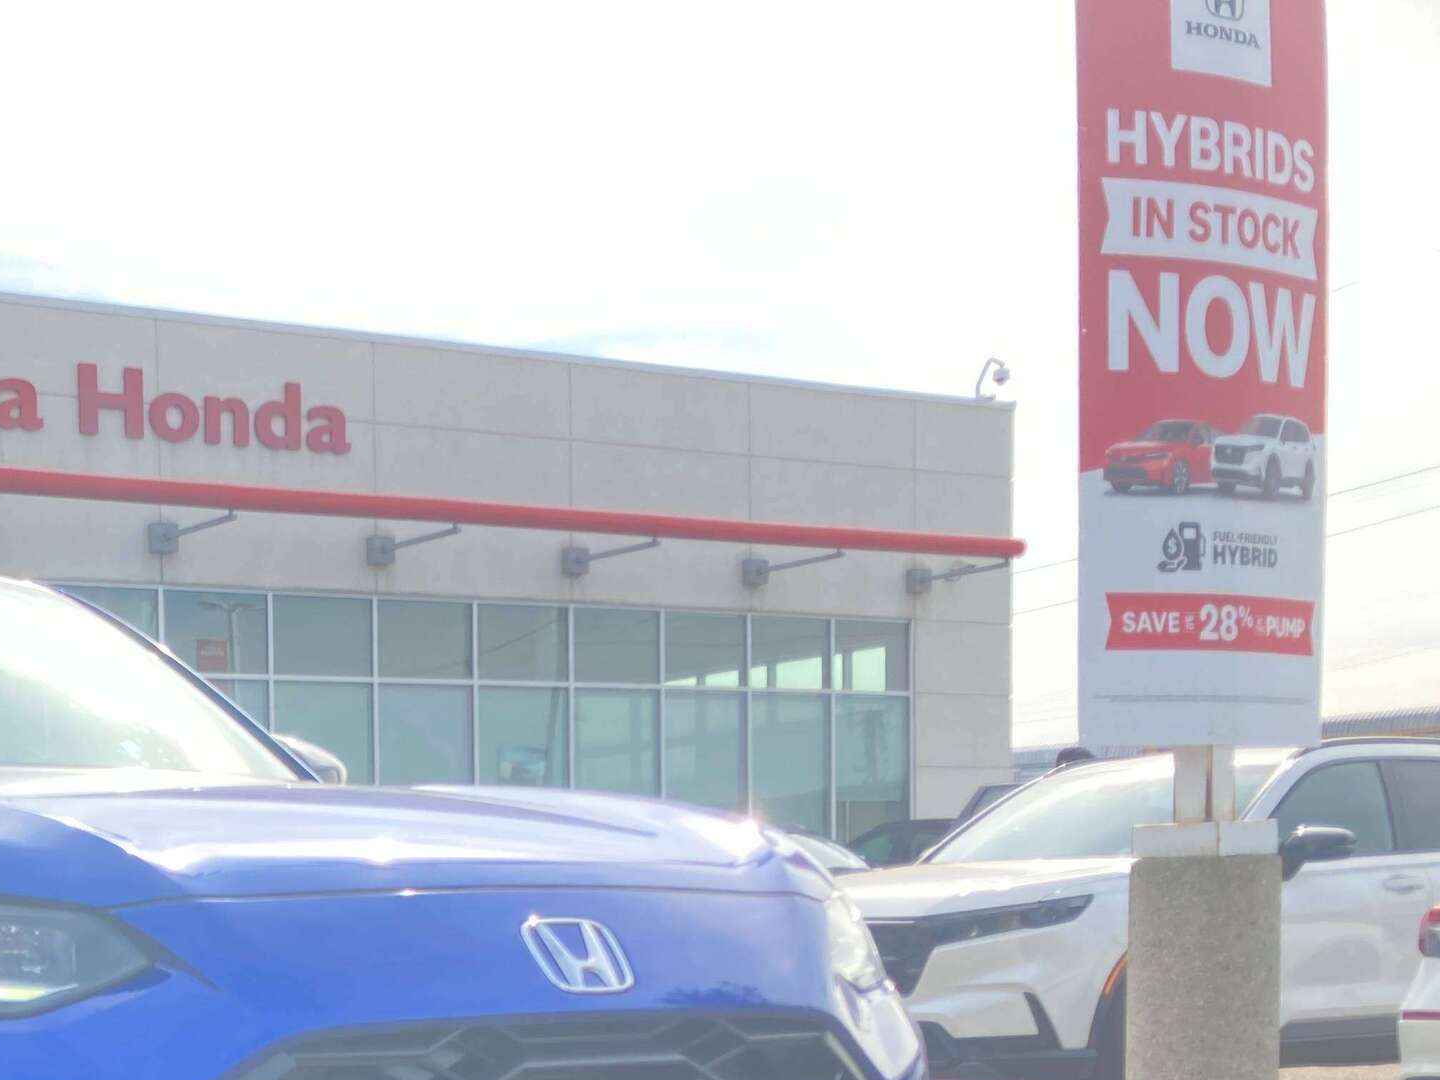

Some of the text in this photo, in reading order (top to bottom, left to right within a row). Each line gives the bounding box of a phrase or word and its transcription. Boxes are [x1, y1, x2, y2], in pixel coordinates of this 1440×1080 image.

[1185, 20, 1260, 49] HONDA
[1106, 108, 1315, 192] HYBRIDS
[1131, 196, 1300, 259] IN STOCK
[1107, 269, 1317, 388] NOW
[77, 363, 351, 454] Honda
[1213, 544, 1278, 568] HYBRID
[1122, 611, 1180, 633] SAVE
[1199, 603, 1254, 641] 28%
[1266, 615, 1306, 639] PUMP
